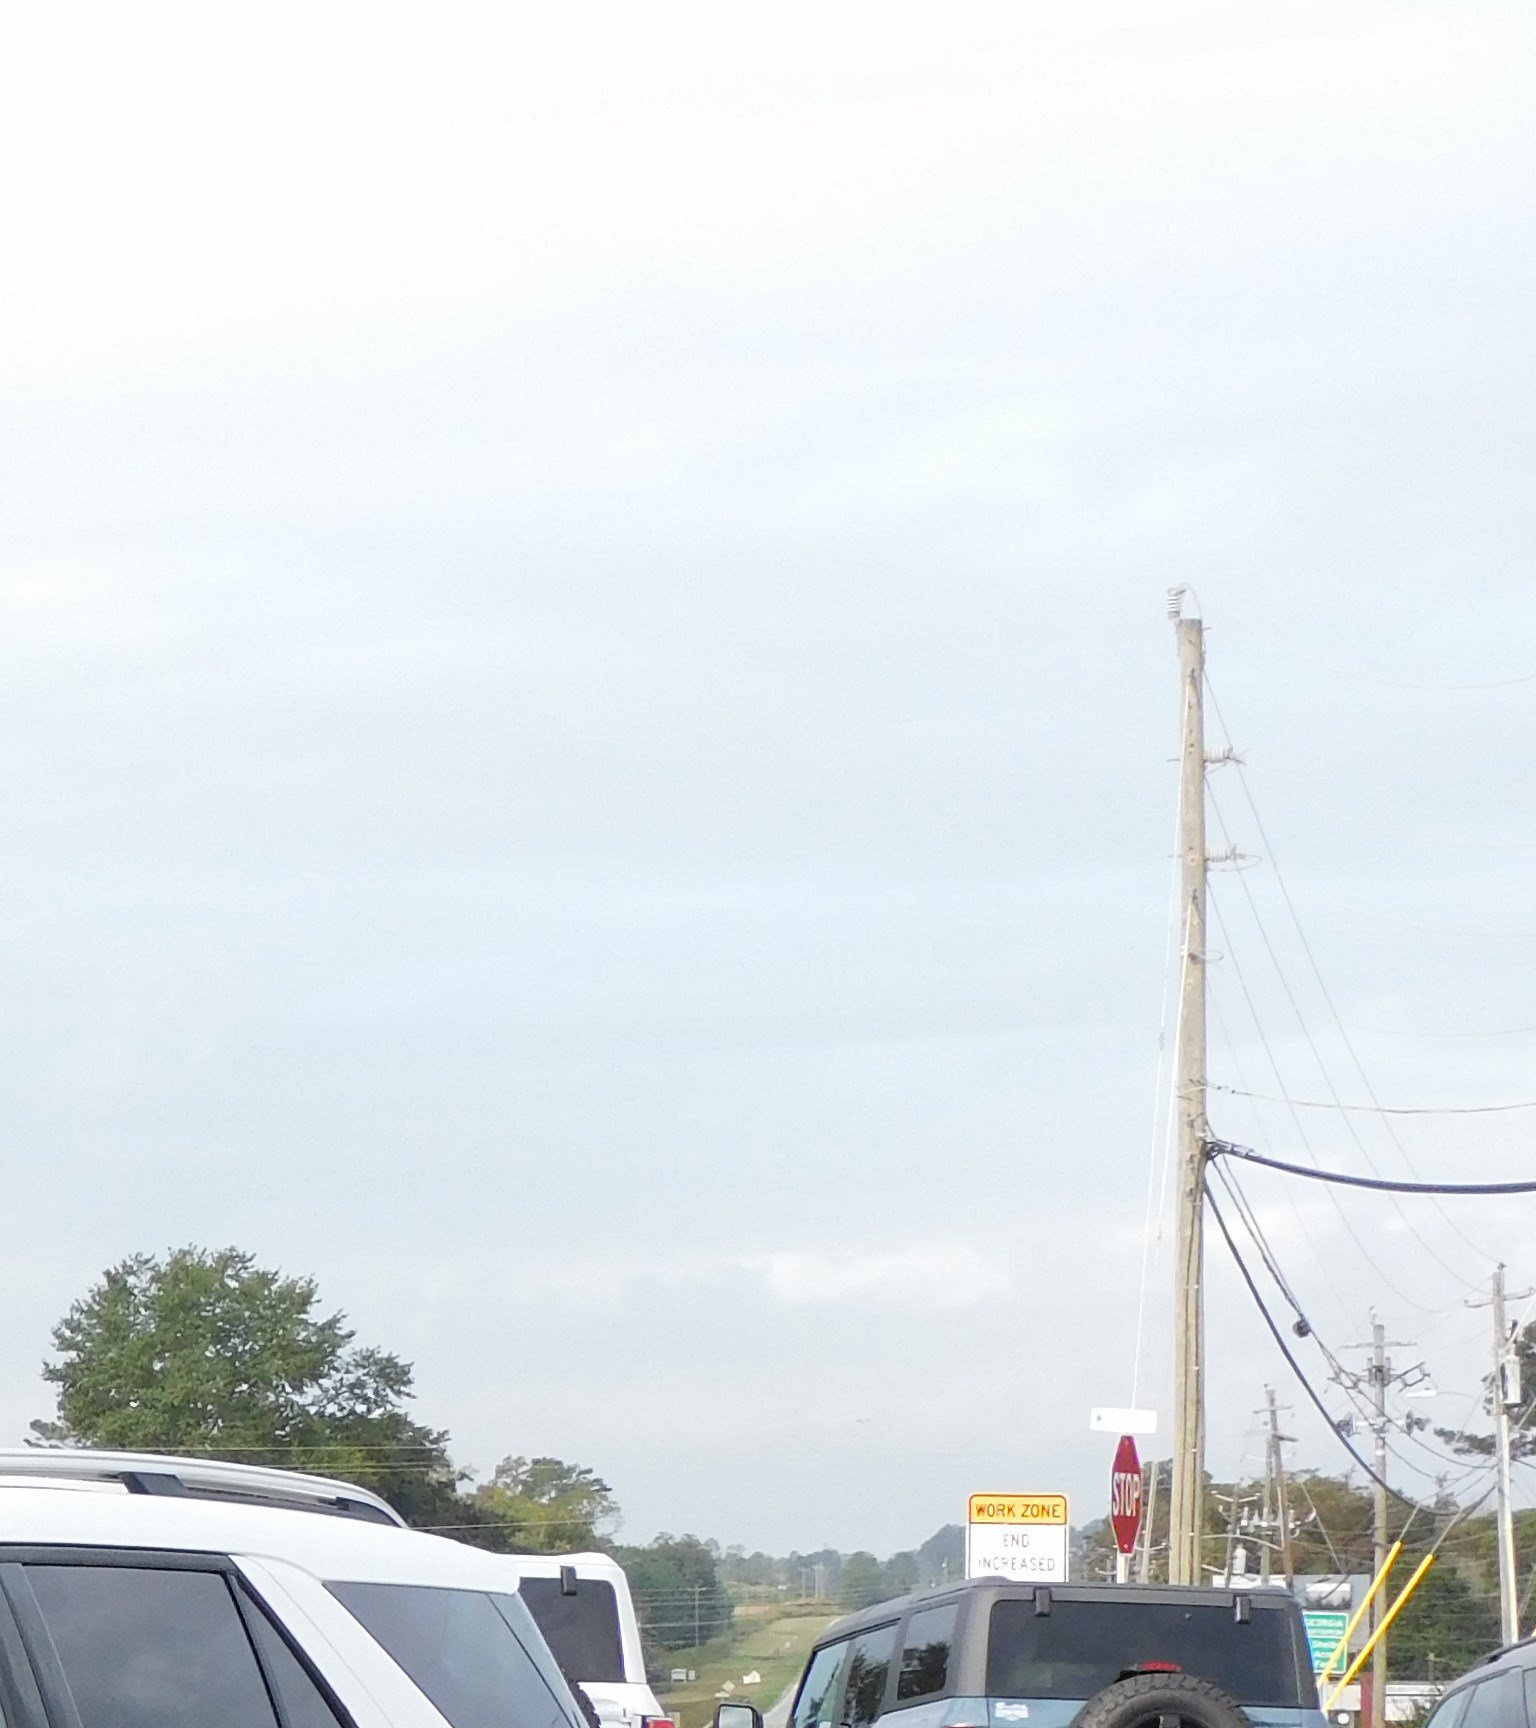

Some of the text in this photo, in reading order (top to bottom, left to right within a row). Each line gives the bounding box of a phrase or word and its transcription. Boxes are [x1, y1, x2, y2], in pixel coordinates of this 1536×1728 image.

[1113, 1472, 1140, 1516] STOP
[975, 1504, 1061, 1518] WORK ZONE
[1003, 1534, 1030, 1548] END
